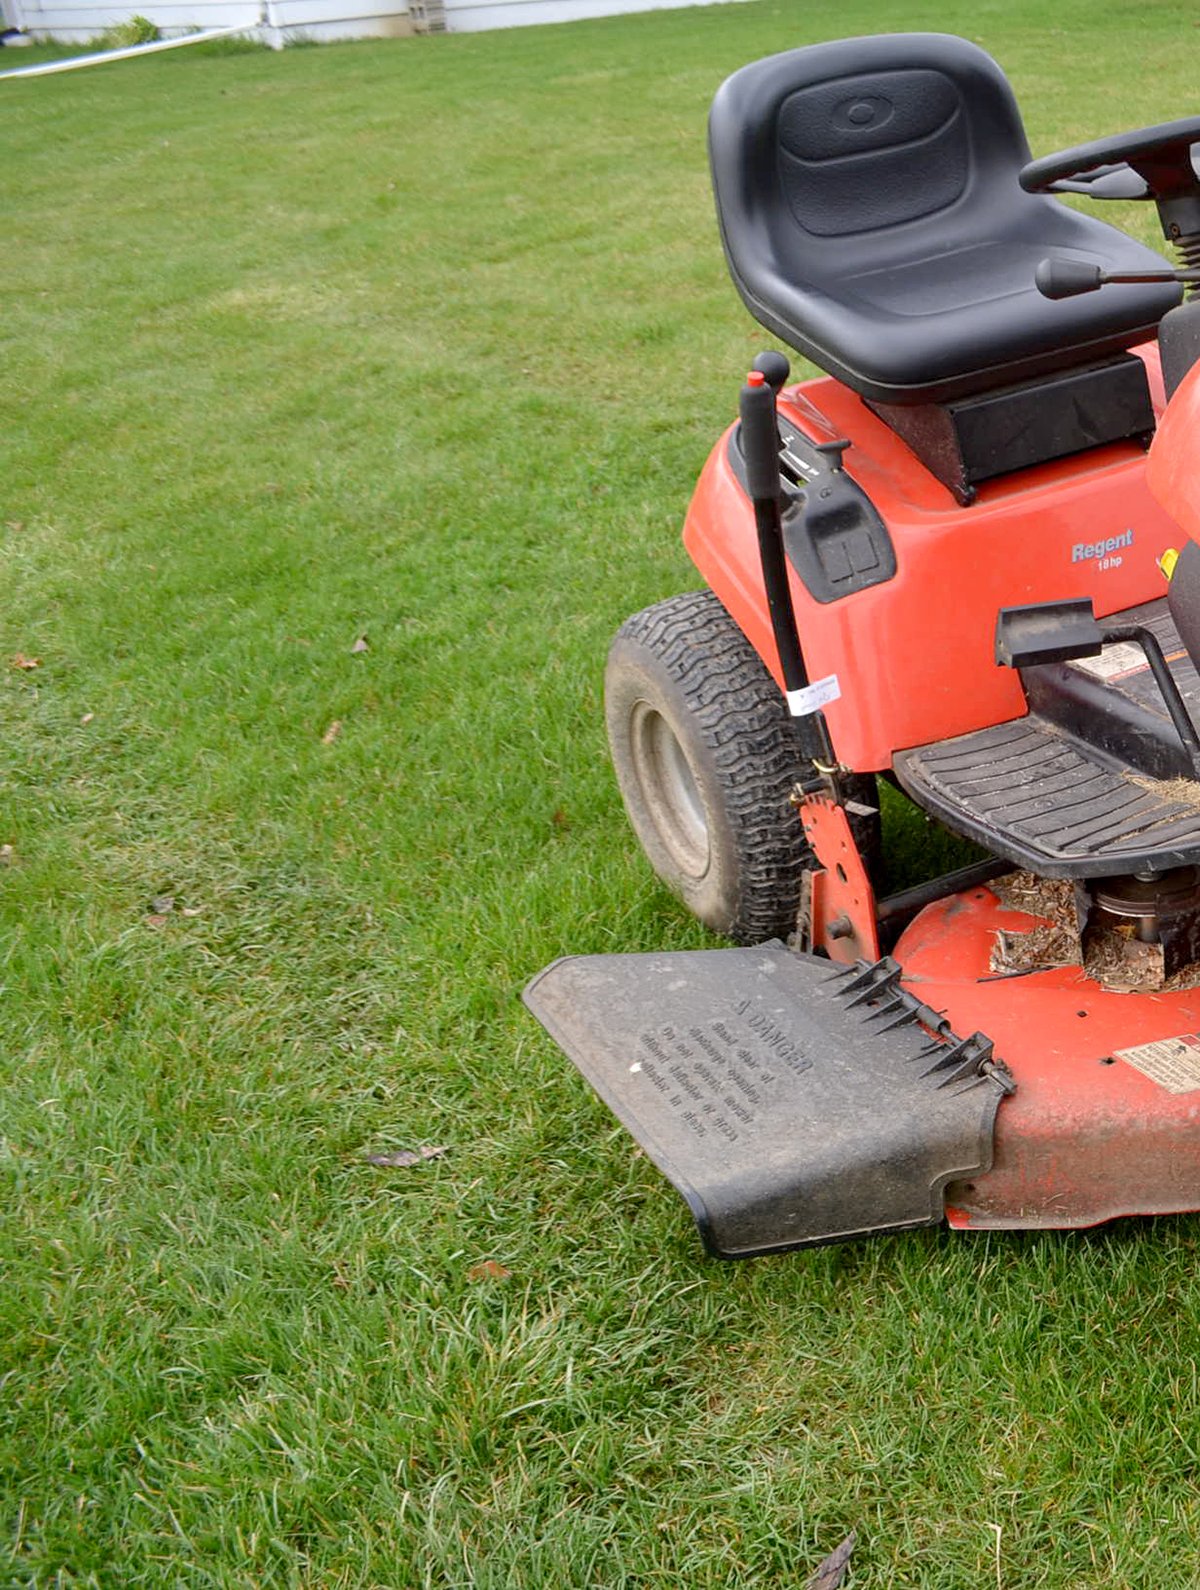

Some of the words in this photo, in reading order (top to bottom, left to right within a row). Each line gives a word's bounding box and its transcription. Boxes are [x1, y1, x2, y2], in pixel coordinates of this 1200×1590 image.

[1072, 529, 1133, 562] Regent
[689, 1028, 726, 1065] discharge
[712, 1022, 739, 1046] Stand
[737, 1050, 760, 1070] clear
[749, 1014, 814, 1075] DANGER
[640, 1034, 671, 1064] without
[669, 1065, 704, 1100] deflector
[703, 1104, 717, 1115] or
[714, 1117, 739, 1142] grass
[662, 1026, 676, 1040] Do
[676, 1044, 694, 1059] not
[693, 1063, 724, 1093] operate
[724, 1096, 753, 1124] mower
[670, 1095, 682, 1107] in
